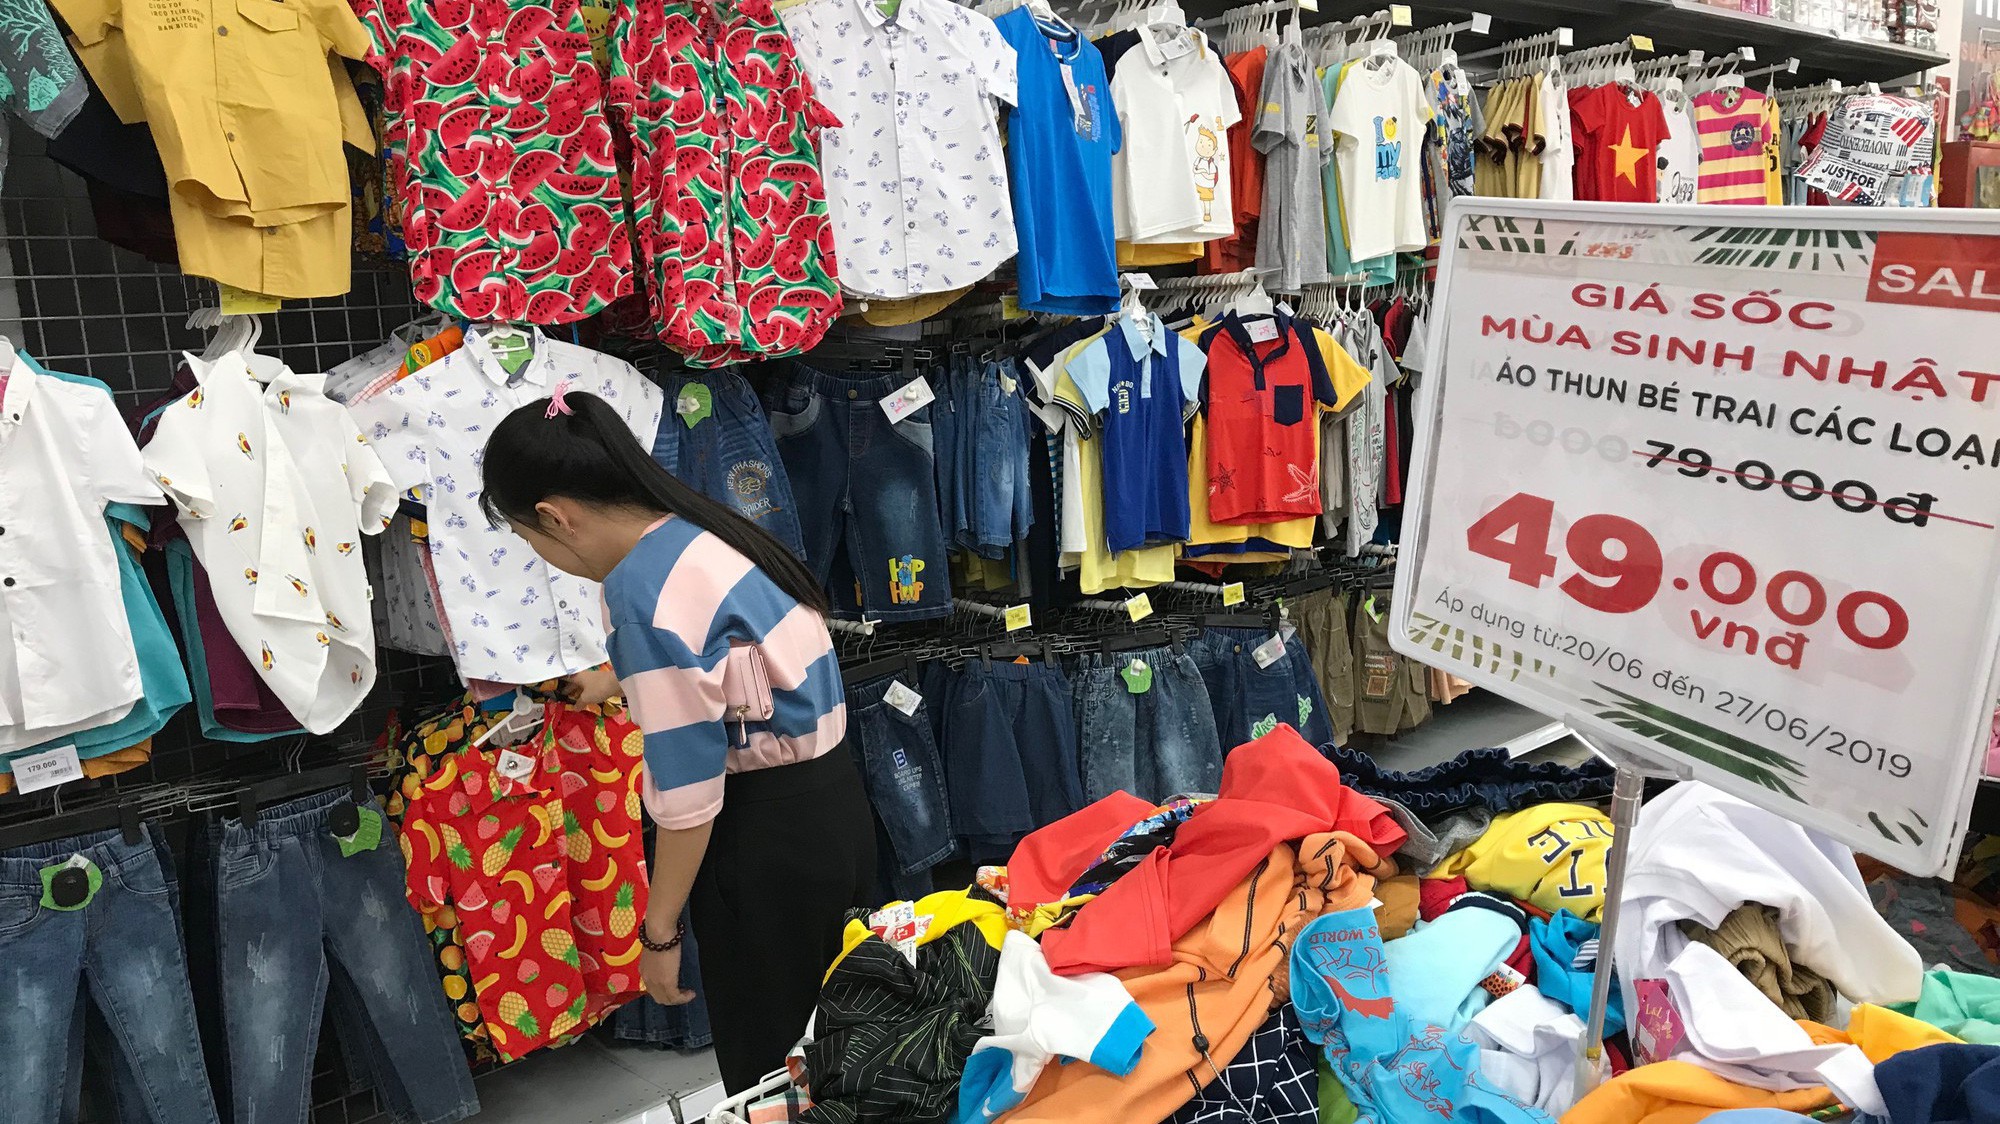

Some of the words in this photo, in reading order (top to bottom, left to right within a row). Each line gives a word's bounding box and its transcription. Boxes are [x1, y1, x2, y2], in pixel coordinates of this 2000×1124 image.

[1375, 140, 1402, 168] my
[1571, 282, 1669, 315] GIÁ
[1690, 288, 1836, 330] SỐC
[1480, 314, 1592, 351] MÙA
[1610, 330, 1755, 372] SINH
[1783, 350, 2000, 402] NHẬT
[1496, 355, 1537, 387] ÁO
[1546, 368, 1628, 403] THUN
[1638, 381, 1681, 412] BÉ
[1692, 391, 1777, 428] TRAI
[1789, 405, 1876, 445] CÁC
[1646, 440, 1938, 527] 79.000đ
[1466, 491, 1910, 650] 49.000
[1690, 609, 1810, 670] vnđ
[1435, 586, 1464, 614] Áp
[1470, 603, 1526, 639] dụng
[1533, 624, 1644, 679] từ:20/06
[1652, 669, 1706, 703] đến
[1714, 690, 1912, 778] 27/06/2019
[27, 759, 57, 773] 179.000
[1308, 928, 1364, 944] WORLD
